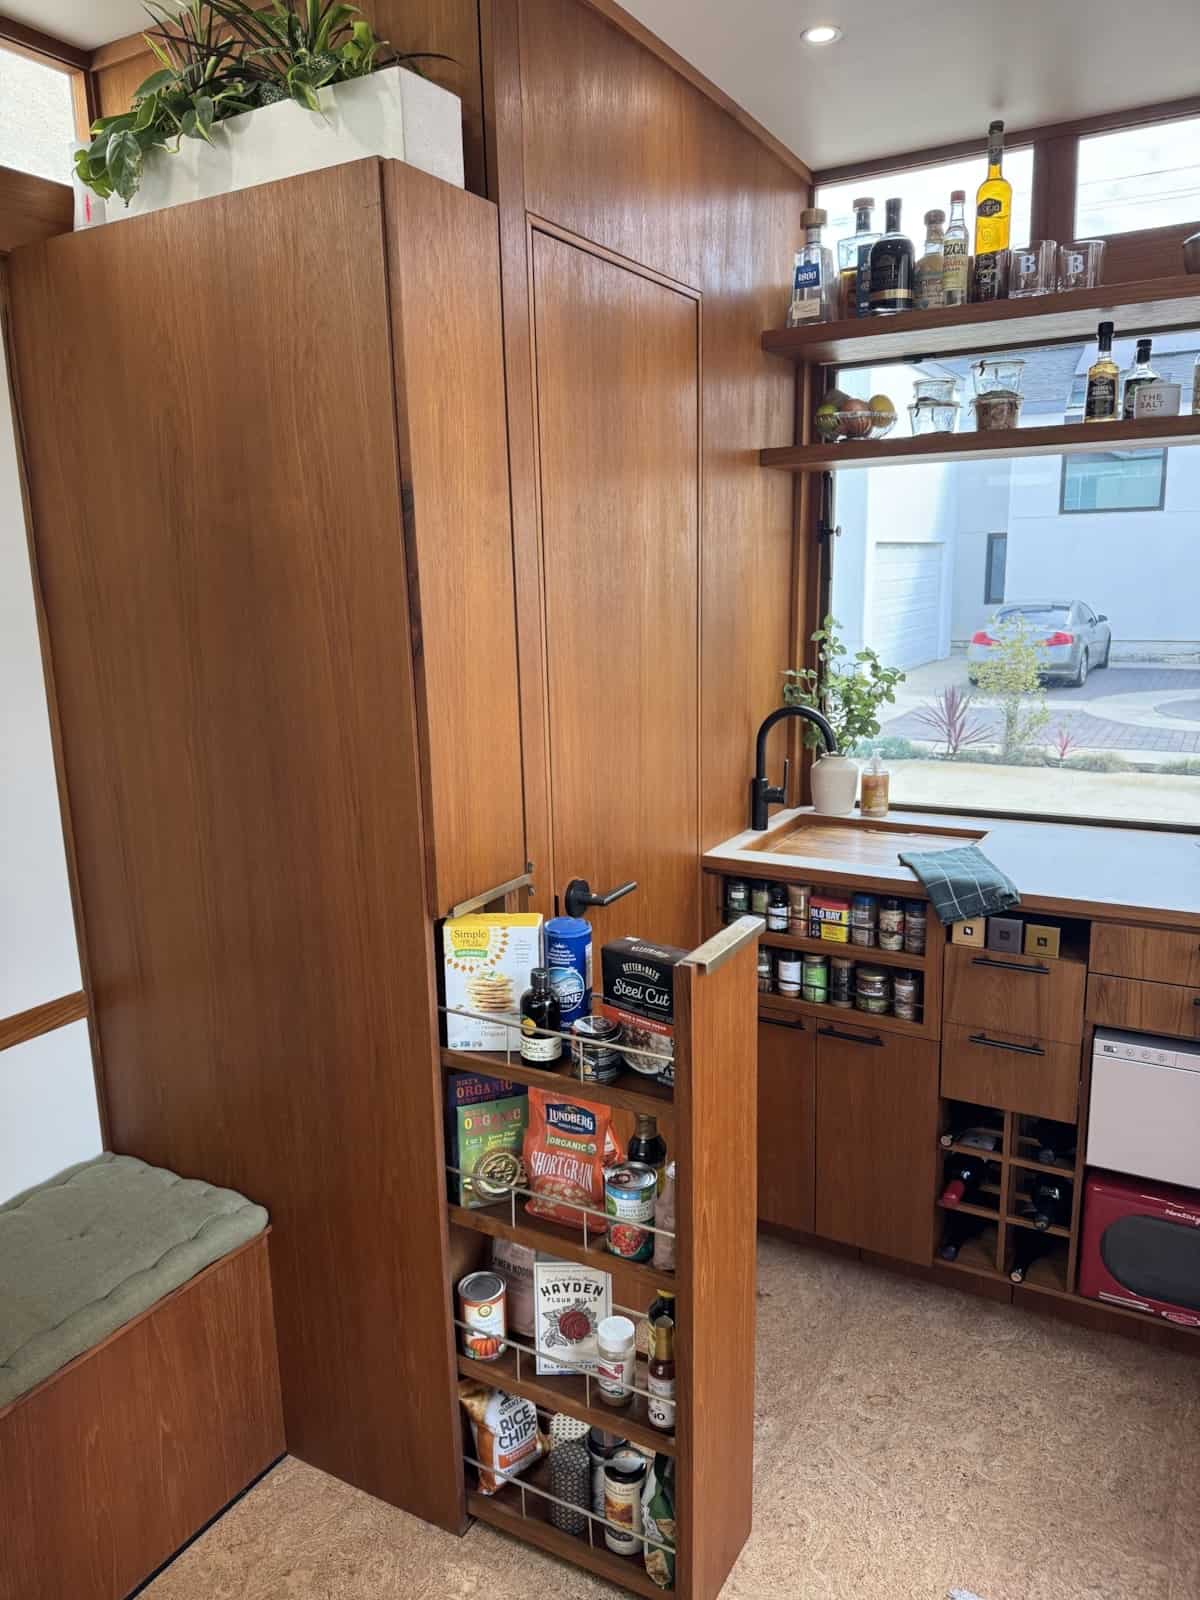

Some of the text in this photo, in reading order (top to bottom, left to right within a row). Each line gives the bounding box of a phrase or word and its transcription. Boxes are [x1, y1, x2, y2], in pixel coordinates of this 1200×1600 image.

[1019, 254, 1037, 273] B
[1067, 254, 1084, 273] B
[454, 928, 488, 940] Simple
[613, 978, 670, 1007] Steel Cut
[548, 1107, 593, 1131] LUNDBERG
[530, 1151, 565, 1177] SHORT
[541, 1282, 604, 1297] HAYDEN
[500, 1404, 531, 1435] RICE
[498, 1414, 537, 1450] CHIPS
